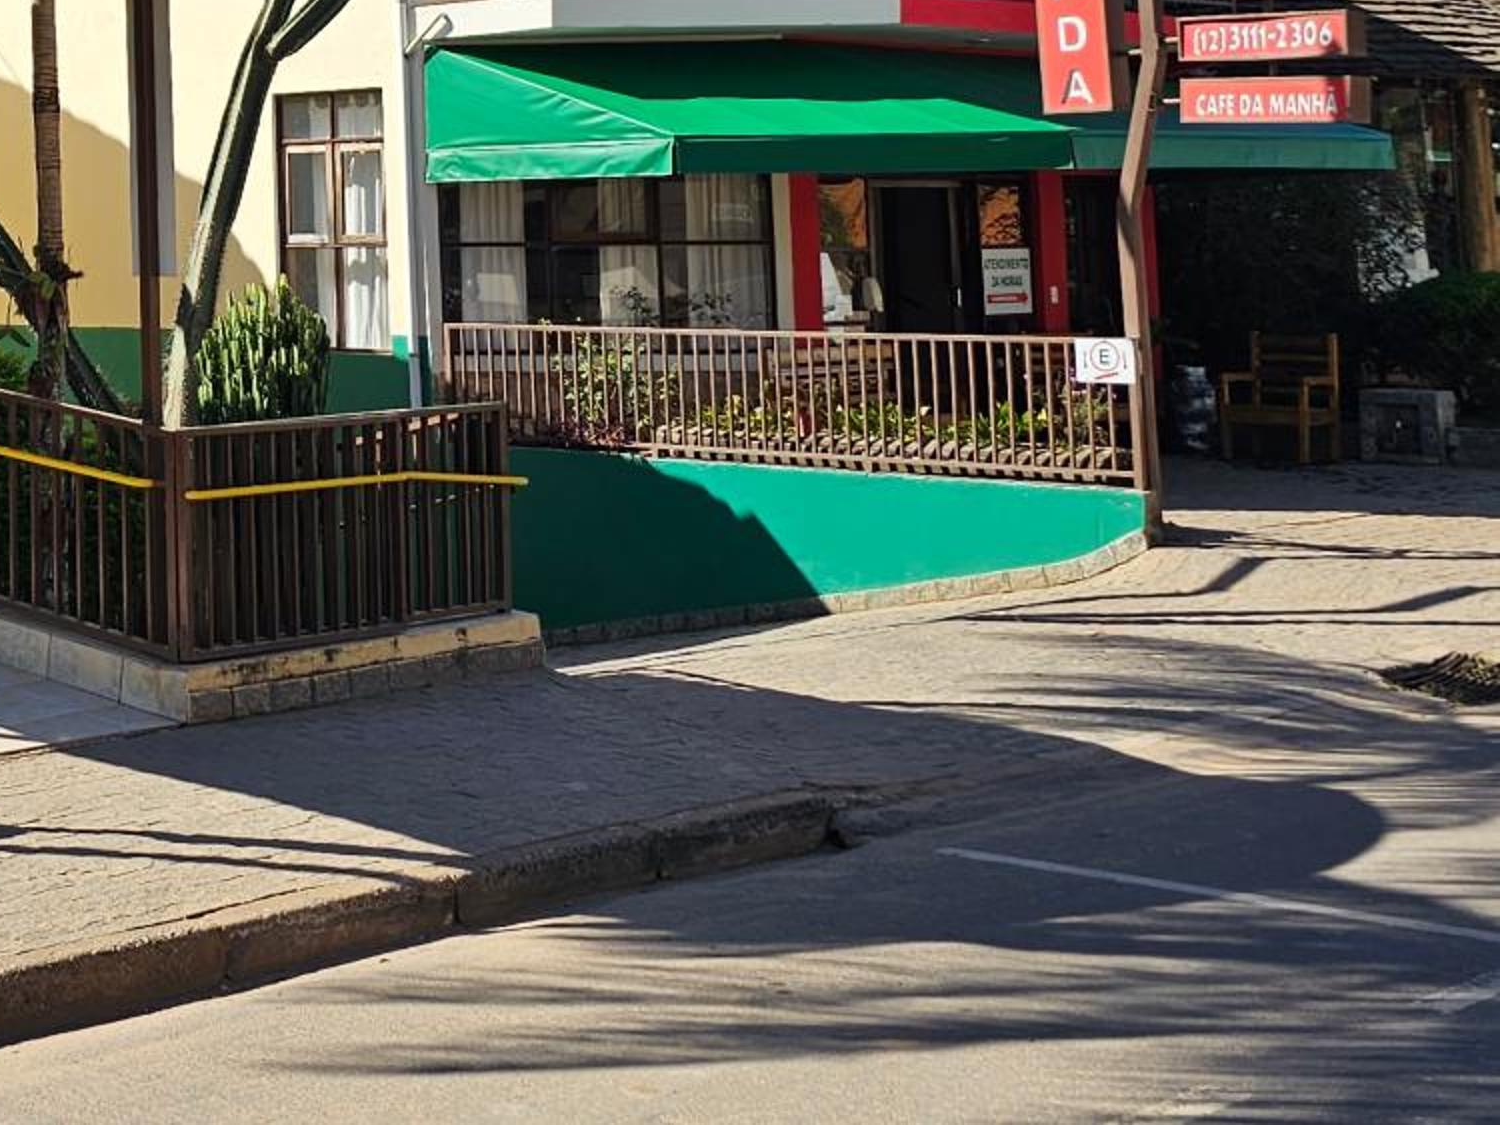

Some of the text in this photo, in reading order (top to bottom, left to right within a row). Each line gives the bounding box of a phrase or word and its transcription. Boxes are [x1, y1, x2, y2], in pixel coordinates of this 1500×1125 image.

[1240, 93, 1264, 116] DA
[1269, 86, 1338, 115] MANHÃ
[1099, 348, 1110, 364] E
